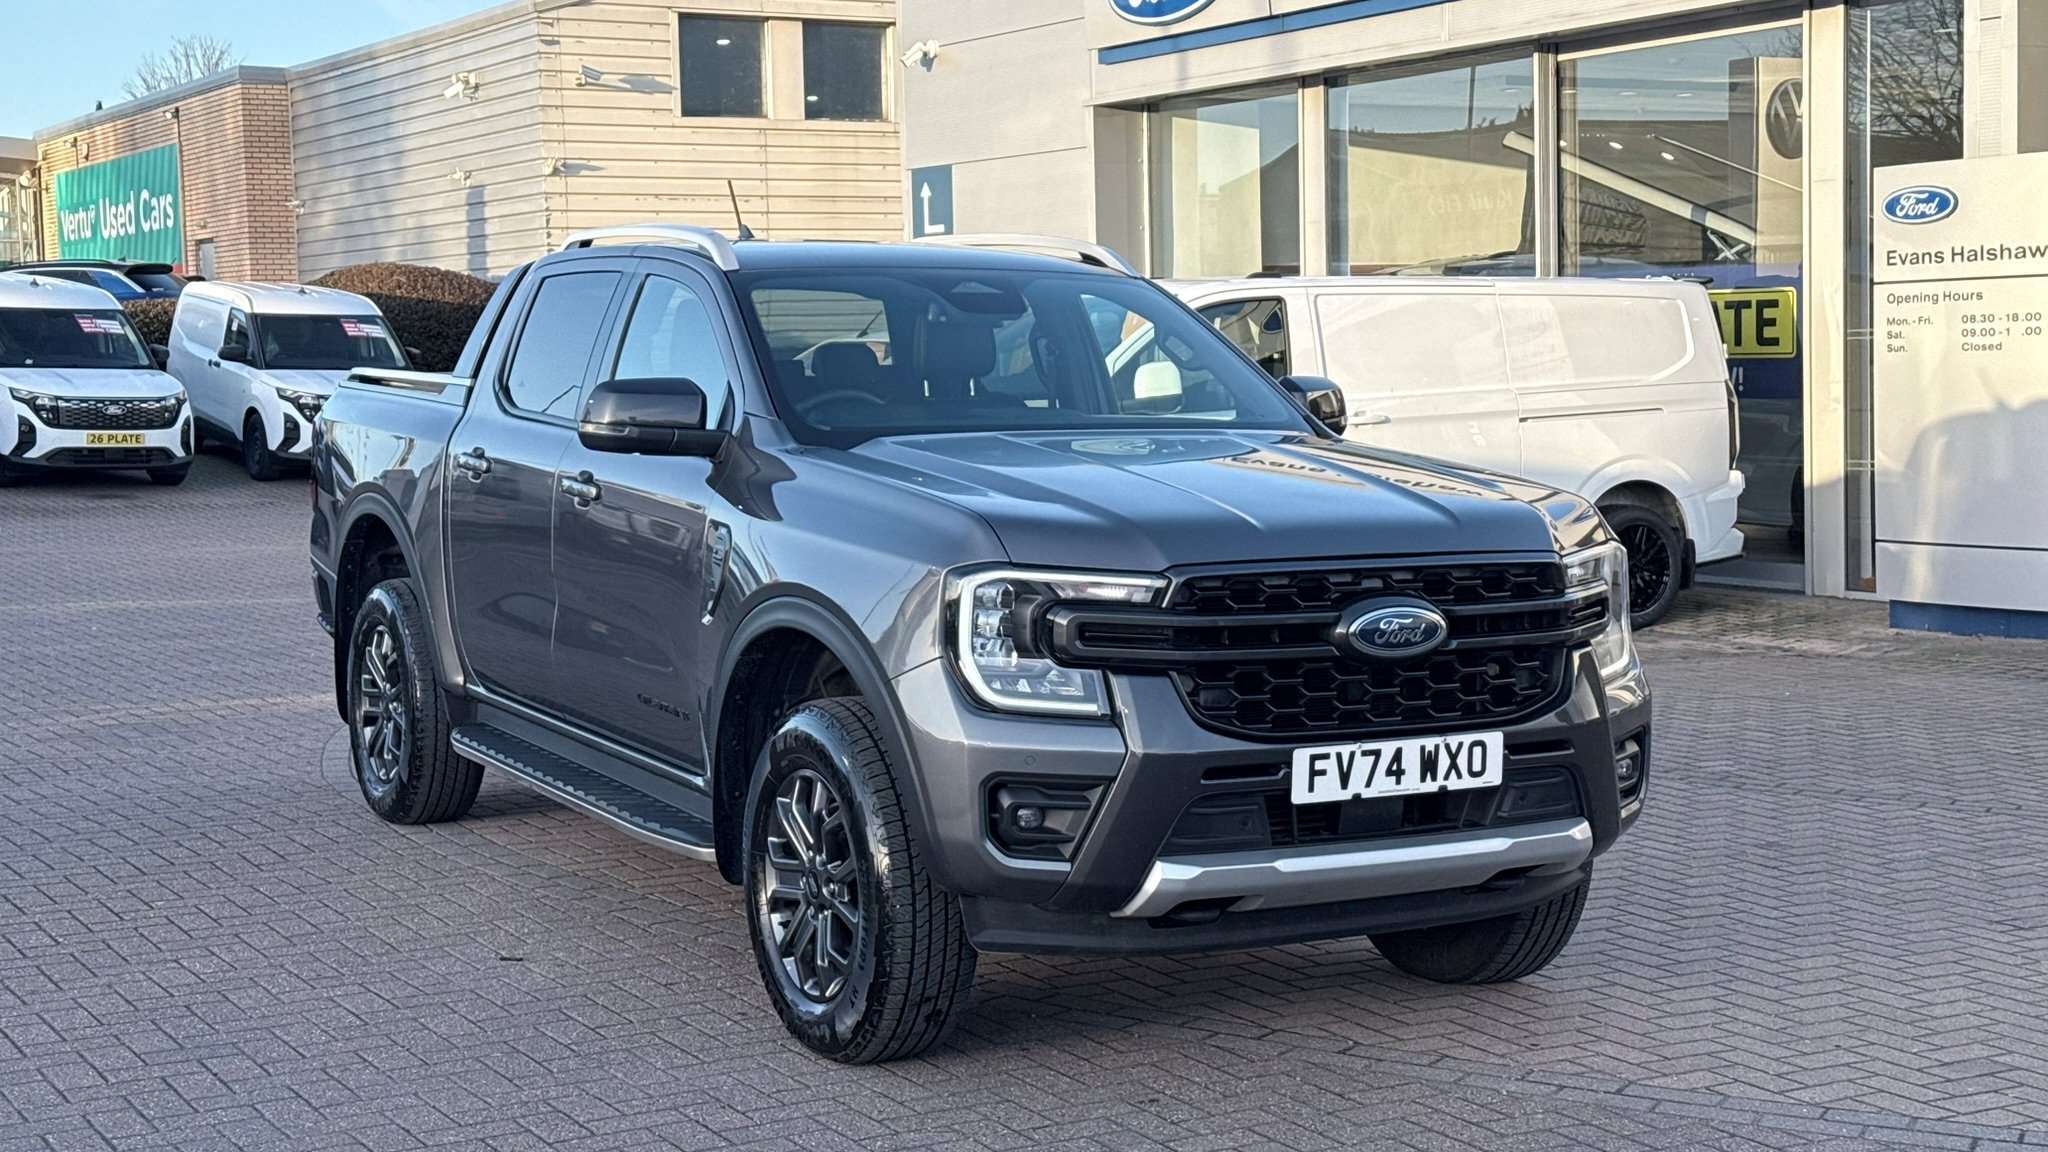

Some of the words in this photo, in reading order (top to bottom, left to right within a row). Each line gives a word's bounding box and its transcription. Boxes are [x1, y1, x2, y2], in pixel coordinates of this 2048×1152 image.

[60, 206, 92, 242] Vertu
[99, 190, 136, 240] Used
[139, 189, 174, 232] Cars
[1895, 192, 1940, 217] Ford
[1886, 249, 1945, 266] Evans
[1951, 243, 2048, 263] Halshaw
[1886, 292, 1939, 306] Opening
[1943, 290, 1984, 302] Hours
[1886, 343, 1908, 353] Sun.
[1961, 341, 2002, 352] Closed
[90, 433, 104, 444] 26
[107, 433, 141, 444] PLATE
[1374, 617, 1426, 644] Ford
[1307, 746, 1406, 793] FV74
[1419, 739, 1487, 783] WXO
